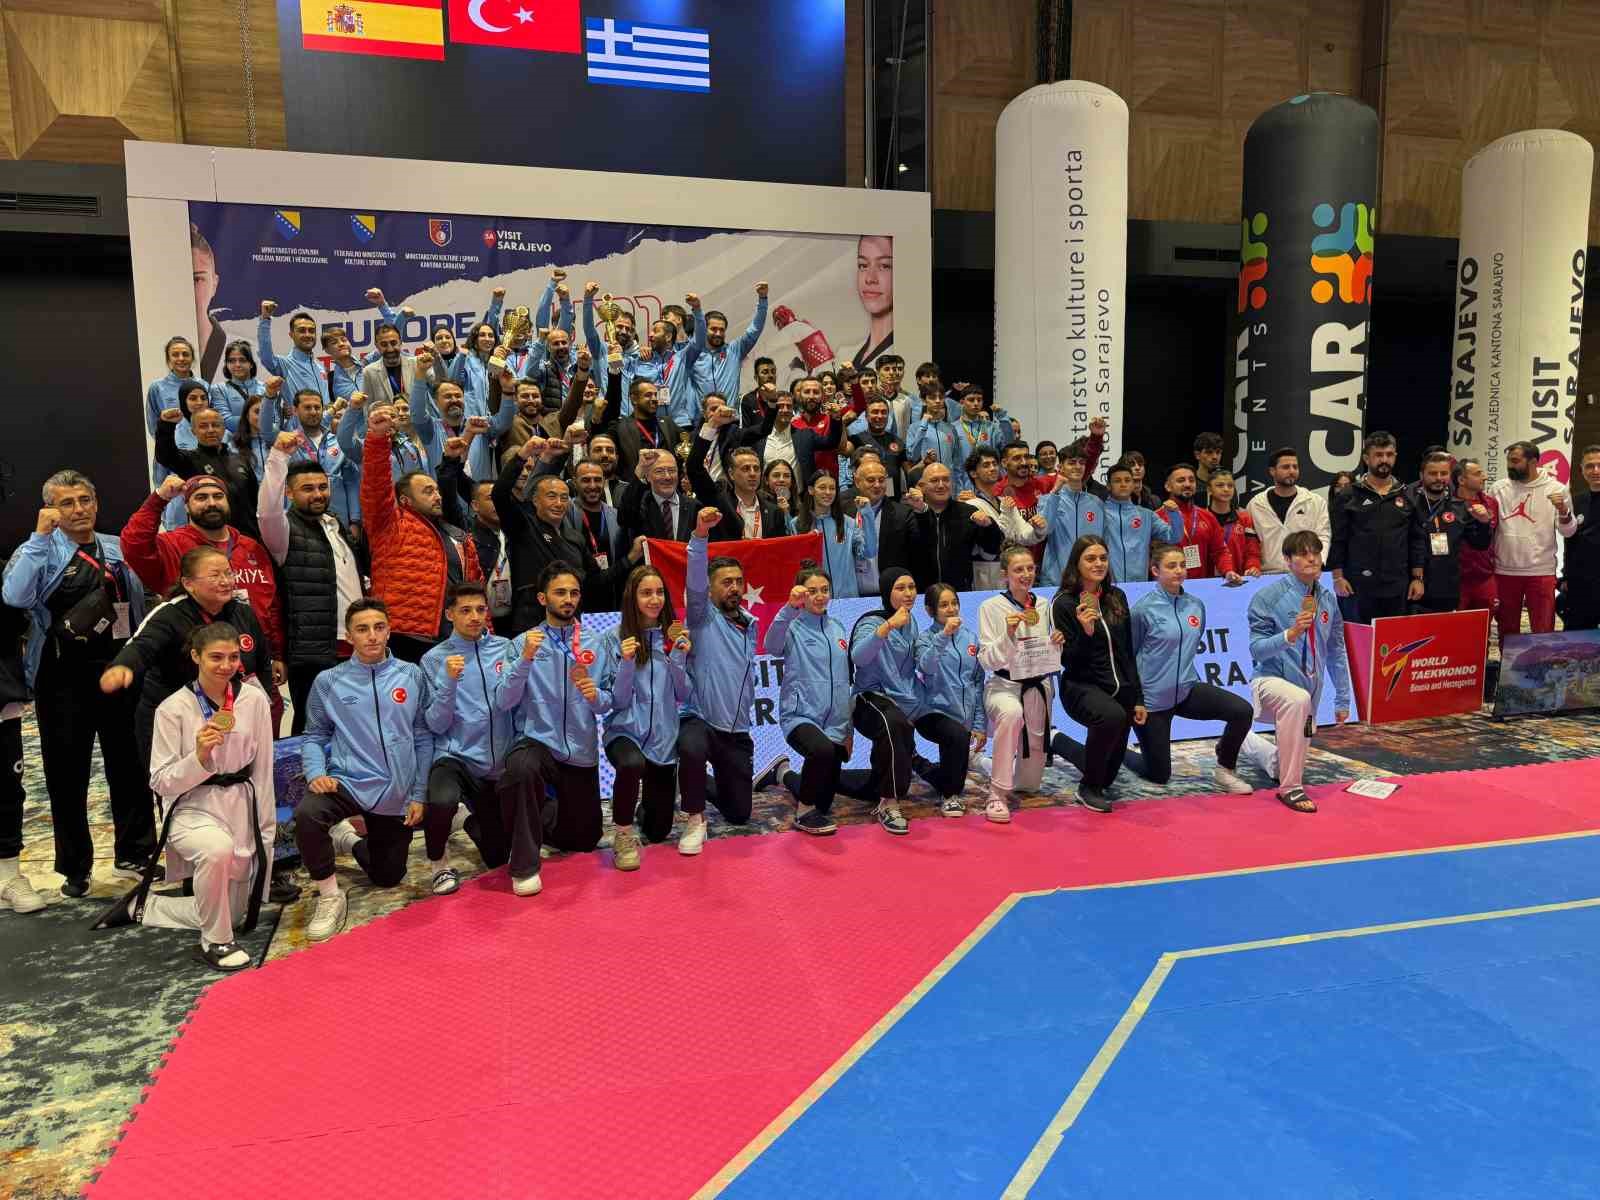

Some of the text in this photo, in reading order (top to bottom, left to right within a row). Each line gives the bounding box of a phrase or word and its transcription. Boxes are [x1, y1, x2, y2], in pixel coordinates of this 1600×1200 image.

[496, 230, 522, 240] VISIT
[1064, 150, 1088, 231] sporta
[497, 241, 552, 252] SARAJEVO
[321, 311, 476, 347] UOPE
[1065, 251, 1086, 340] kulture
[1094, 288, 1113, 393] Sarajevo
[1453, 257, 1479, 447] SARAJEVO
[1485, 252, 1505, 492] RISTIČKA ZAJEDNICA KANTONA SARAJEVO
[1070, 348, 1088, 444] tarstvo
[1251, 322, 1268, 492] VENTS
[1308, 321, 1366, 502] CAR
[1531, 356, 1561, 446] VISIT
[1411, 656, 1449, 668] WORLD
[1411, 665, 1477, 681] TAEKWONDO
[1431, 682, 1442, 691] and
